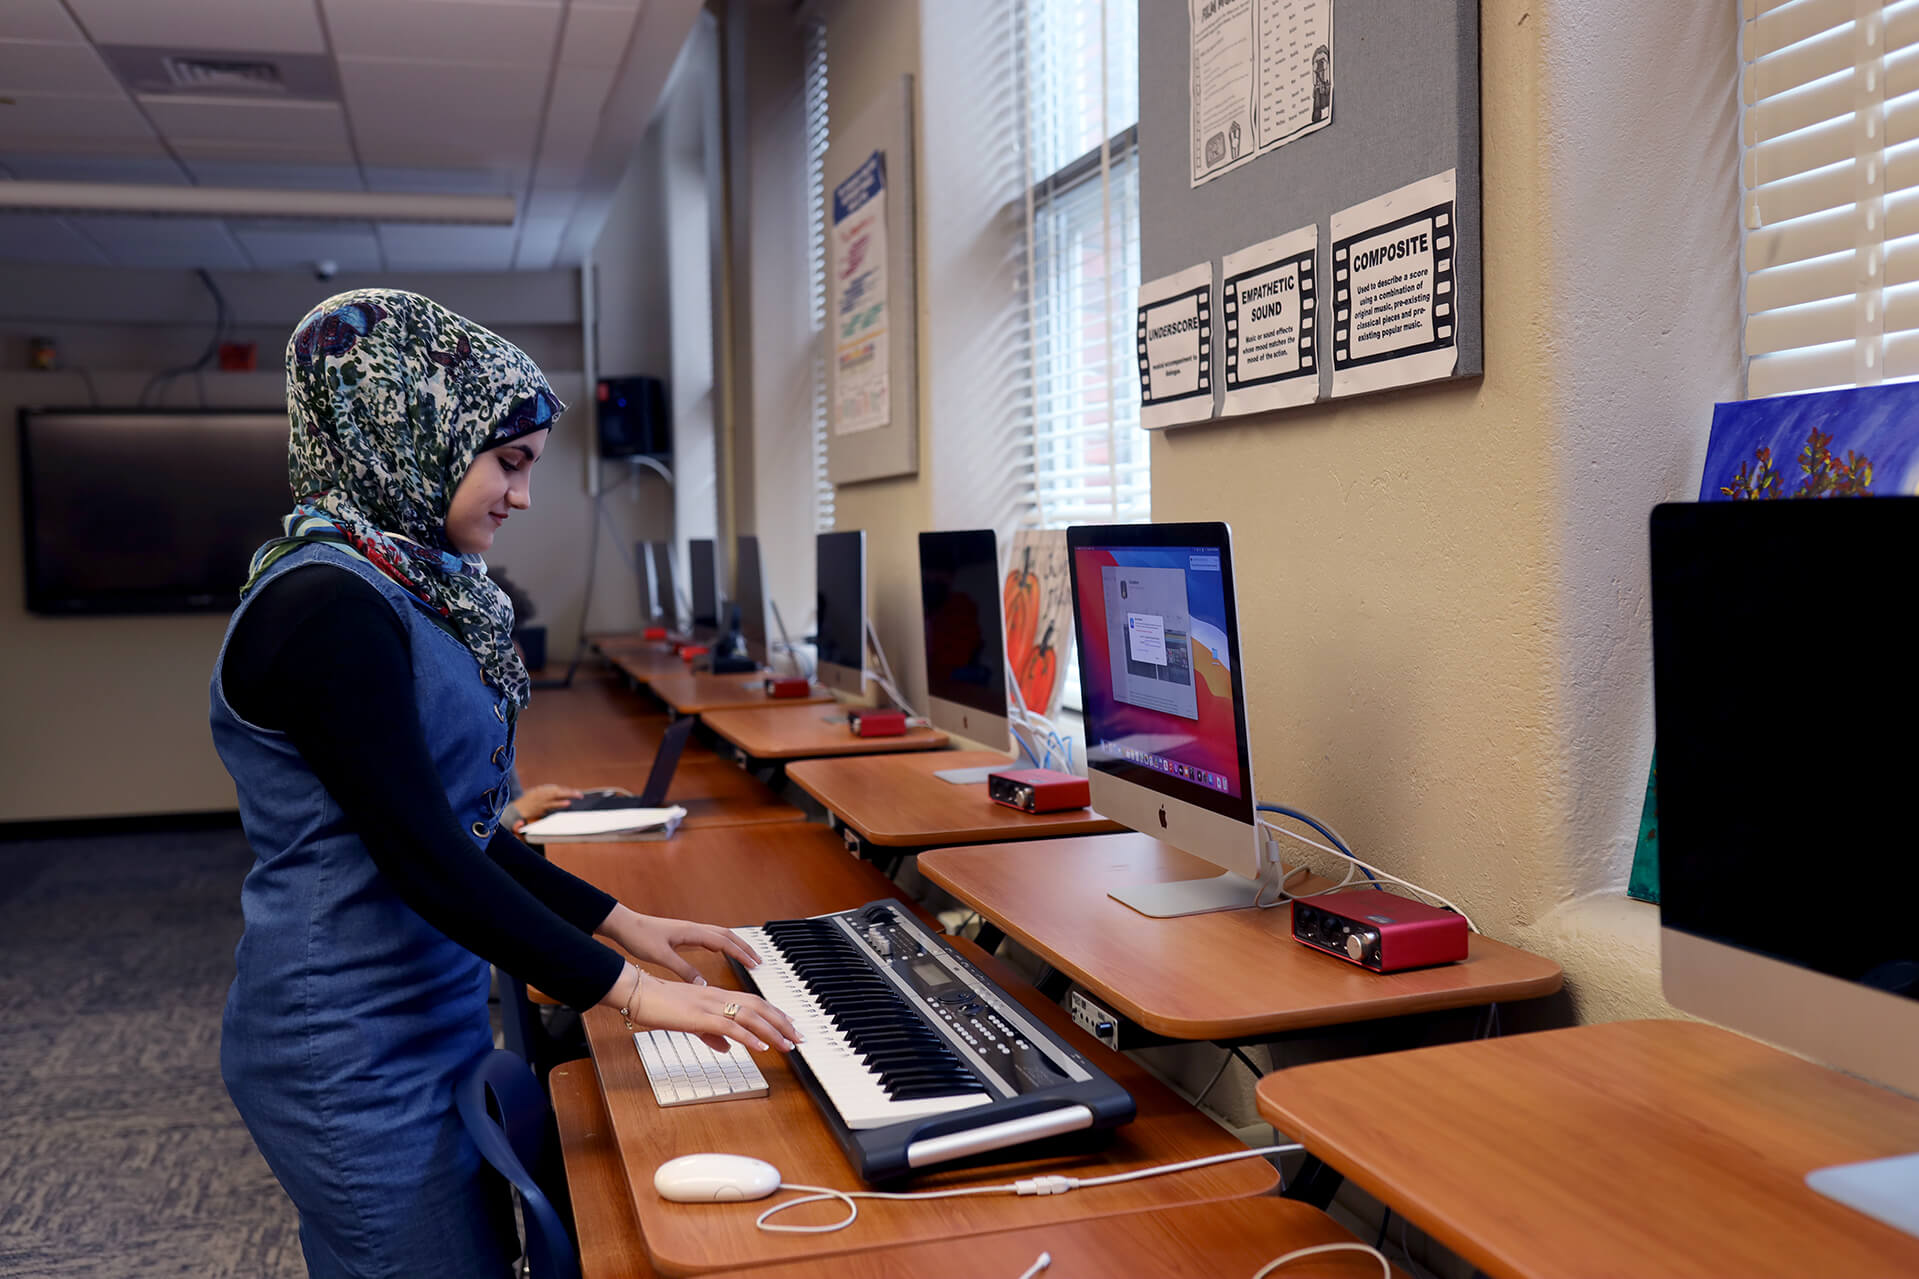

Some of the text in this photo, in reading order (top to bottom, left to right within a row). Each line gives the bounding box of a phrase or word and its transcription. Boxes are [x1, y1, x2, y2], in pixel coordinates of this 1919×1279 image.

[1353, 233, 1428, 272] COMPOSITE
[1241, 275, 1295, 305] EMPATHETIC
[1357, 283, 1369, 294] Used
[1377, 275, 1402, 288] describe
[1409, 269, 1428, 280] score
[1379, 285, 1415, 300] combination
[1416, 280, 1423, 290] of
[1251, 301, 1282, 323] SOUND
[1354, 294, 1430, 320] original music, pre-existing
[1356, 306, 1426, 330] classical pieces and pre-
[1149, 316, 1198, 341] UNDERSCORE
[1357, 320, 1423, 342] existing popular music.
